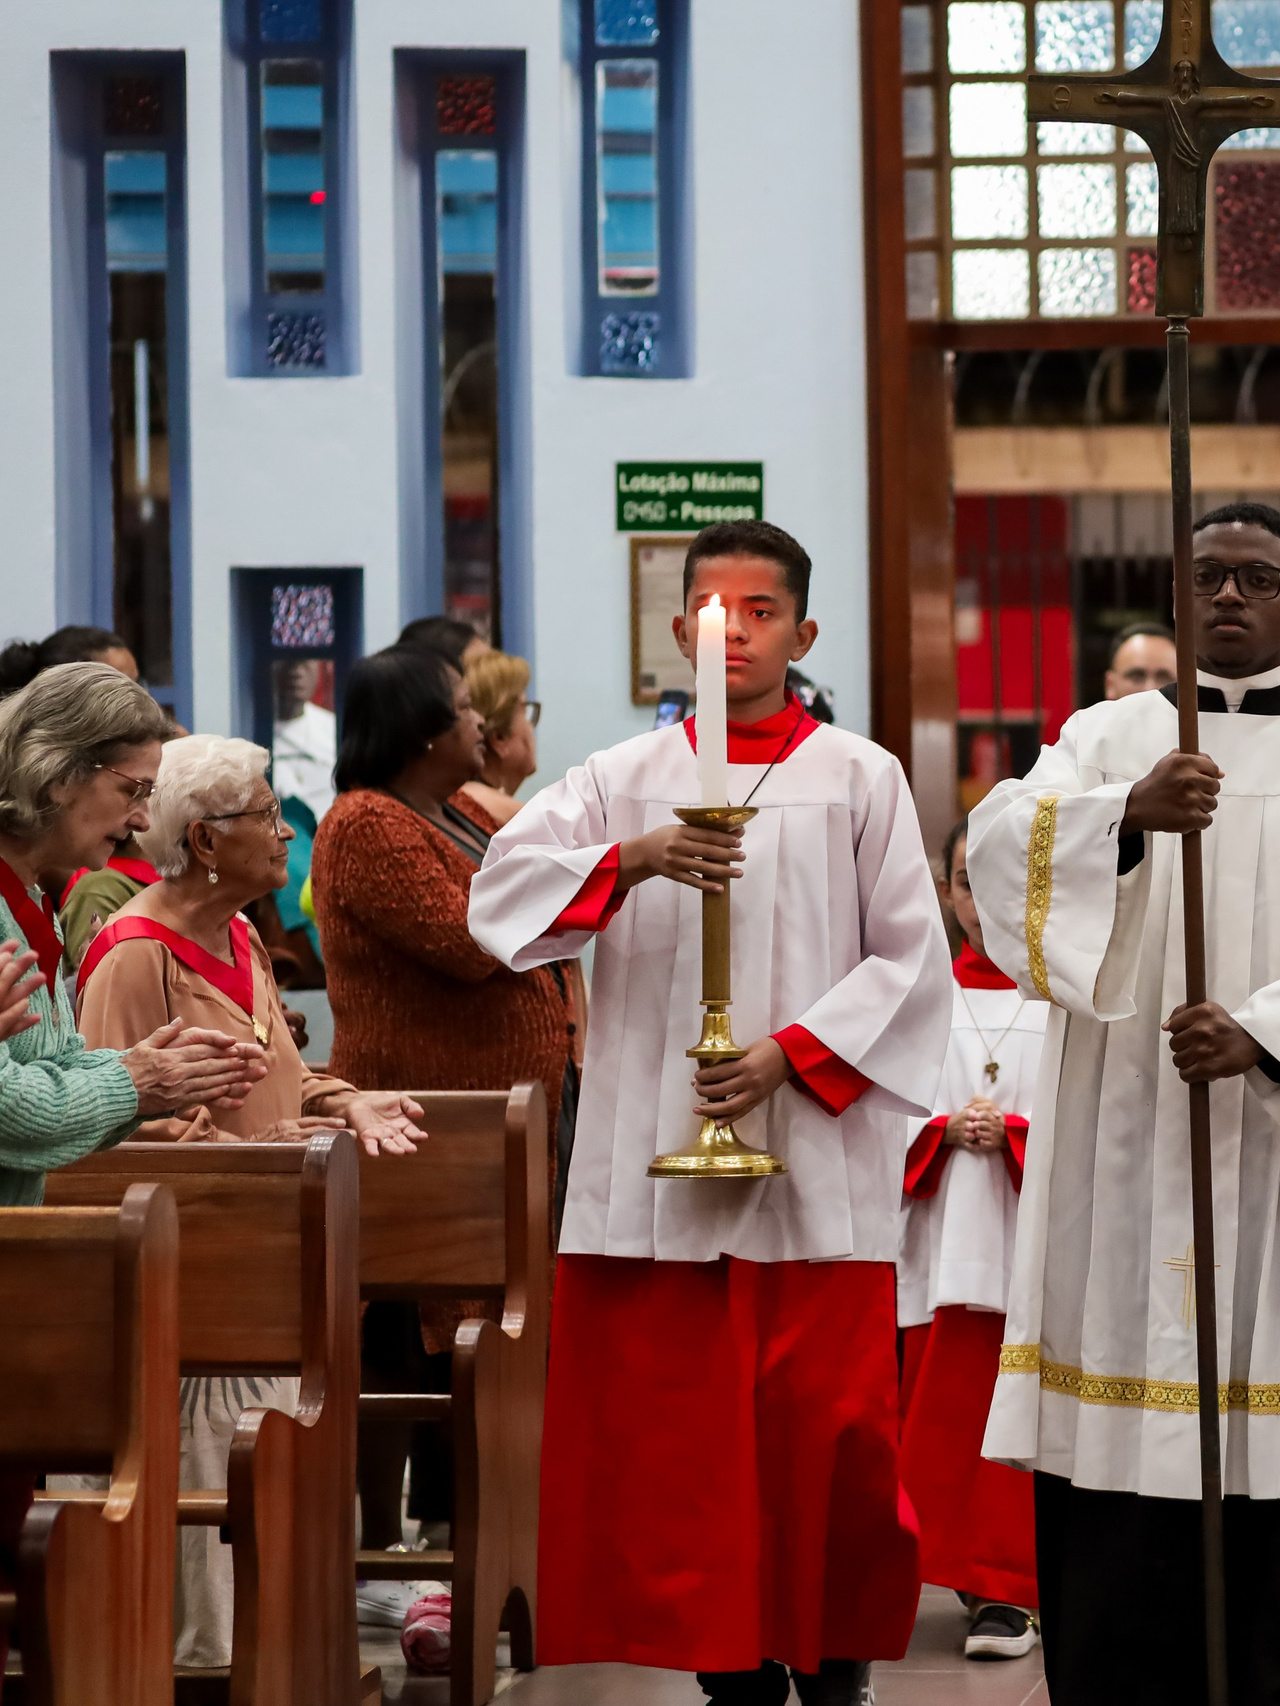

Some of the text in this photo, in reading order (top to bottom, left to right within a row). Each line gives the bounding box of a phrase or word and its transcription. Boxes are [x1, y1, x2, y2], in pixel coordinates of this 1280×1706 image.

[618, 471, 760, 496] Lotação Máxima
[681, 500, 756, 523] Pessoas
